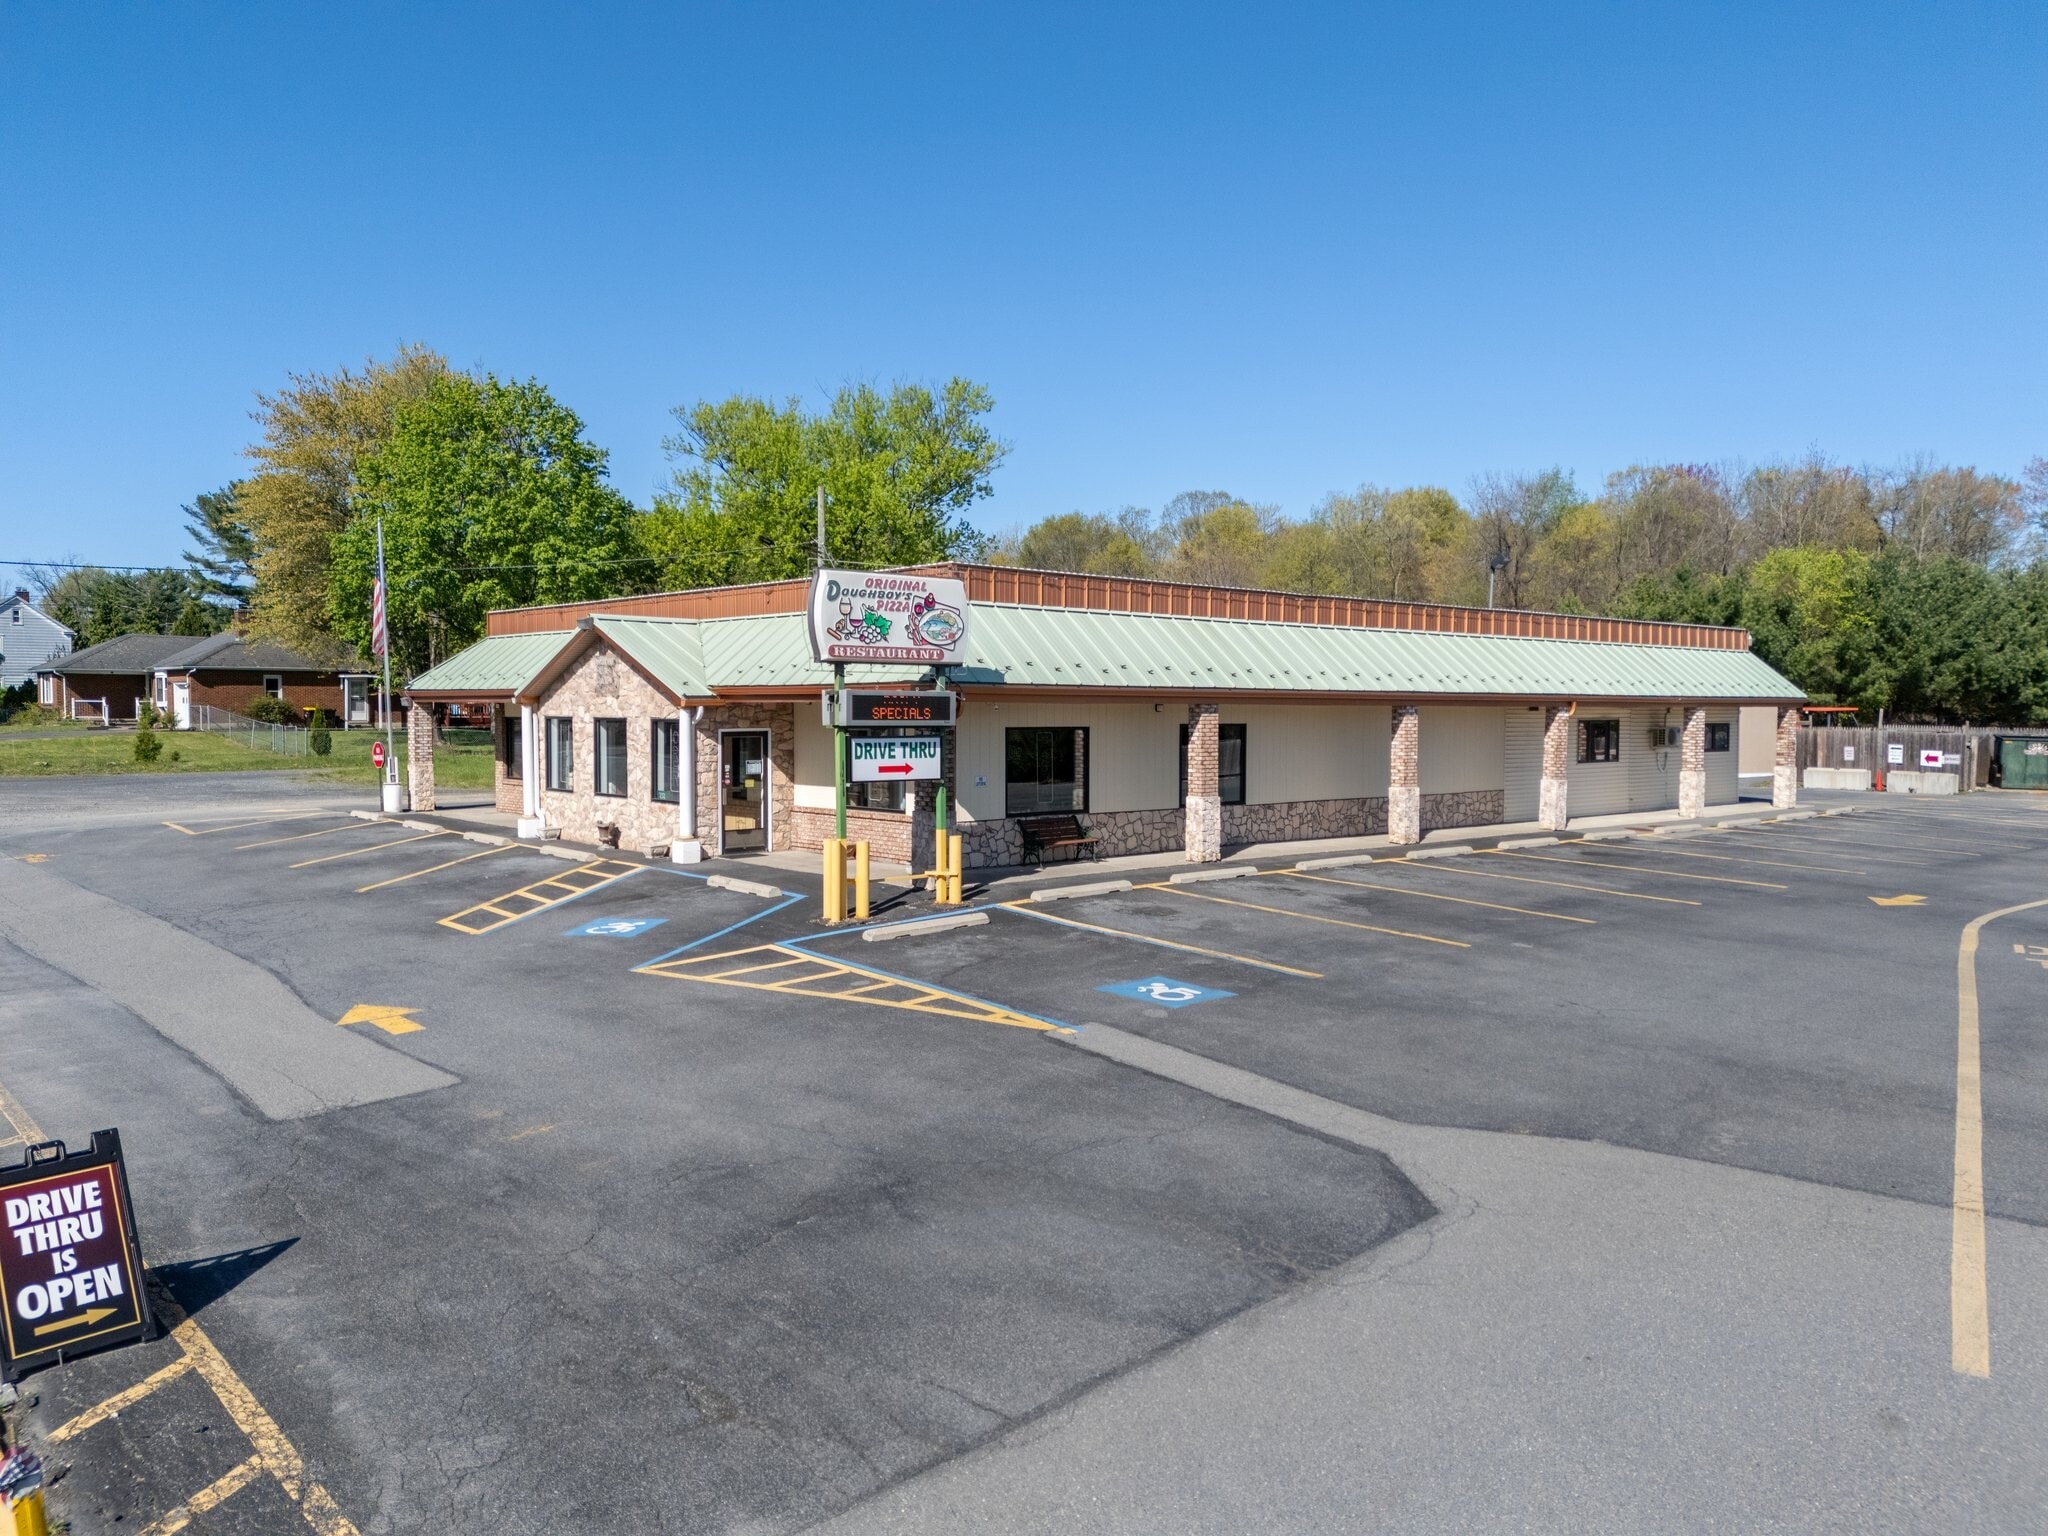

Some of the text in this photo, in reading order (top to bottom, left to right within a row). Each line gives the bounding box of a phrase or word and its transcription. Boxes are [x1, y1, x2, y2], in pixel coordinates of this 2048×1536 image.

[826, 579, 914, 602] DOUGHBOY'S
[864, 577, 928, 592] ORIGINAL
[876, 599, 911, 613] PIZZA
[833, 646, 941, 660] RESTAURANT
[872, 707, 932, 720] SPECIALS
[854, 741, 937, 760] DRIVE THRU
[5, 1179, 103, 1228] DRIVE
[13, 1210, 104, 1256] THRU
[51, 1247, 78, 1275] IS
[16, 1263, 124, 1320] OPEN
